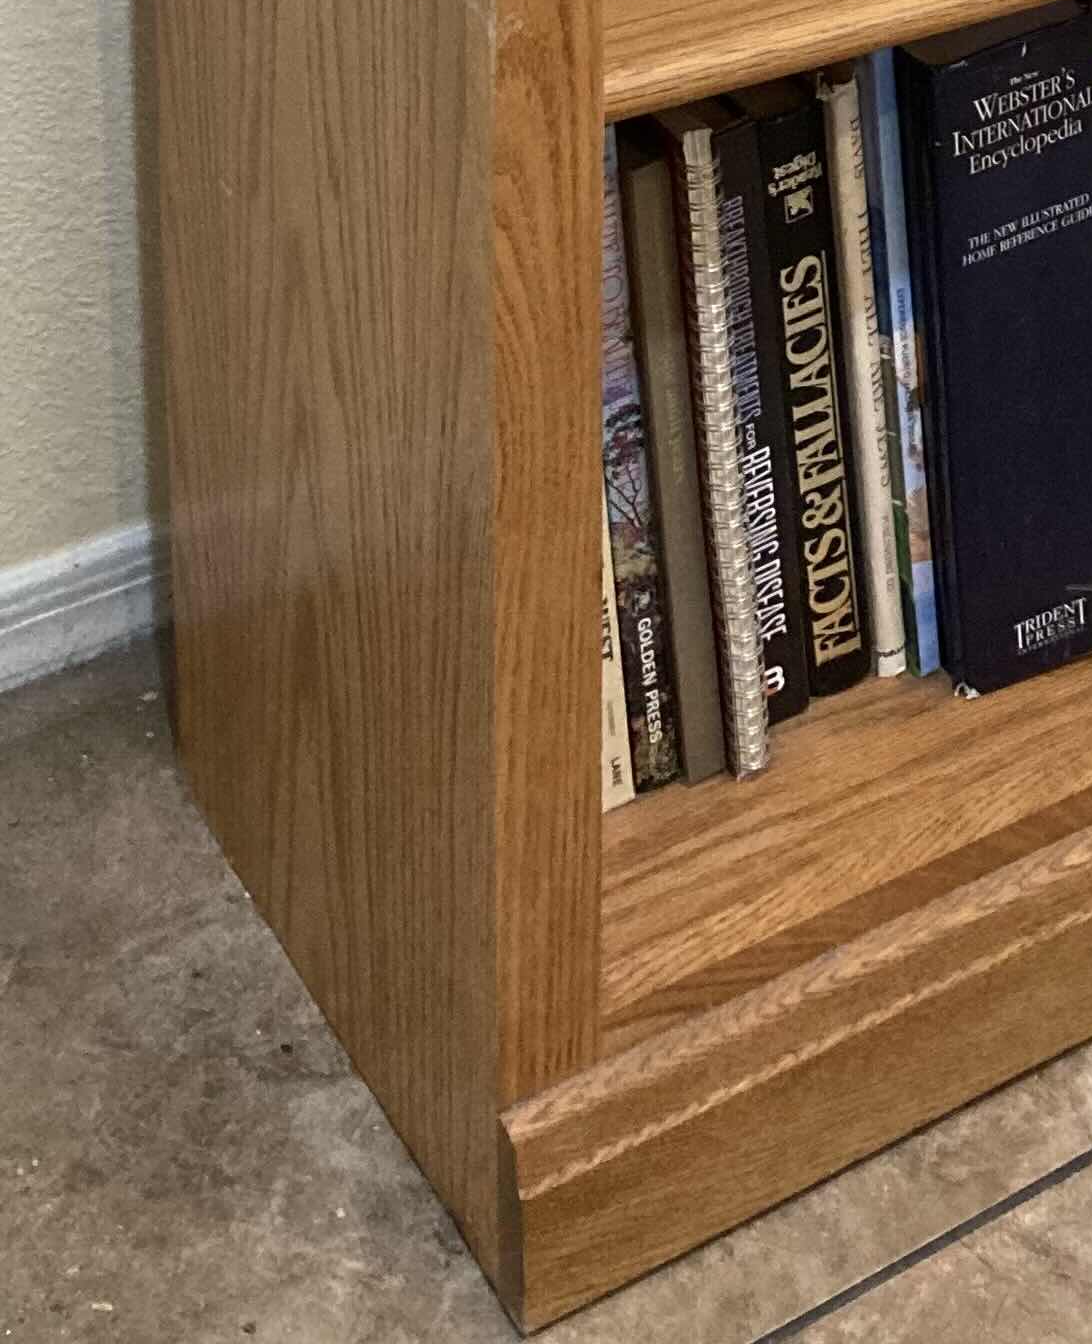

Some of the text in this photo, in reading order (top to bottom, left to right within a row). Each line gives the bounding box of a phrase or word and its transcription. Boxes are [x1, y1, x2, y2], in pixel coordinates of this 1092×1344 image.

[973, 66, 1075, 122] WEBSTER'S
[969, 119, 1082, 175] Encyclopedia
[968, 193, 1090, 249] THE NEW ILLUSTRATED
[781, 255, 847, 480] FALLACIES
[802, 480, 845, 529] &
[804, 527, 864, 668] FACTS
[1013, 597, 1087, 649] TRIDENT
[1025, 619, 1076, 644] PRESS
[637, 617, 666, 743] GOLDEN PRESS
